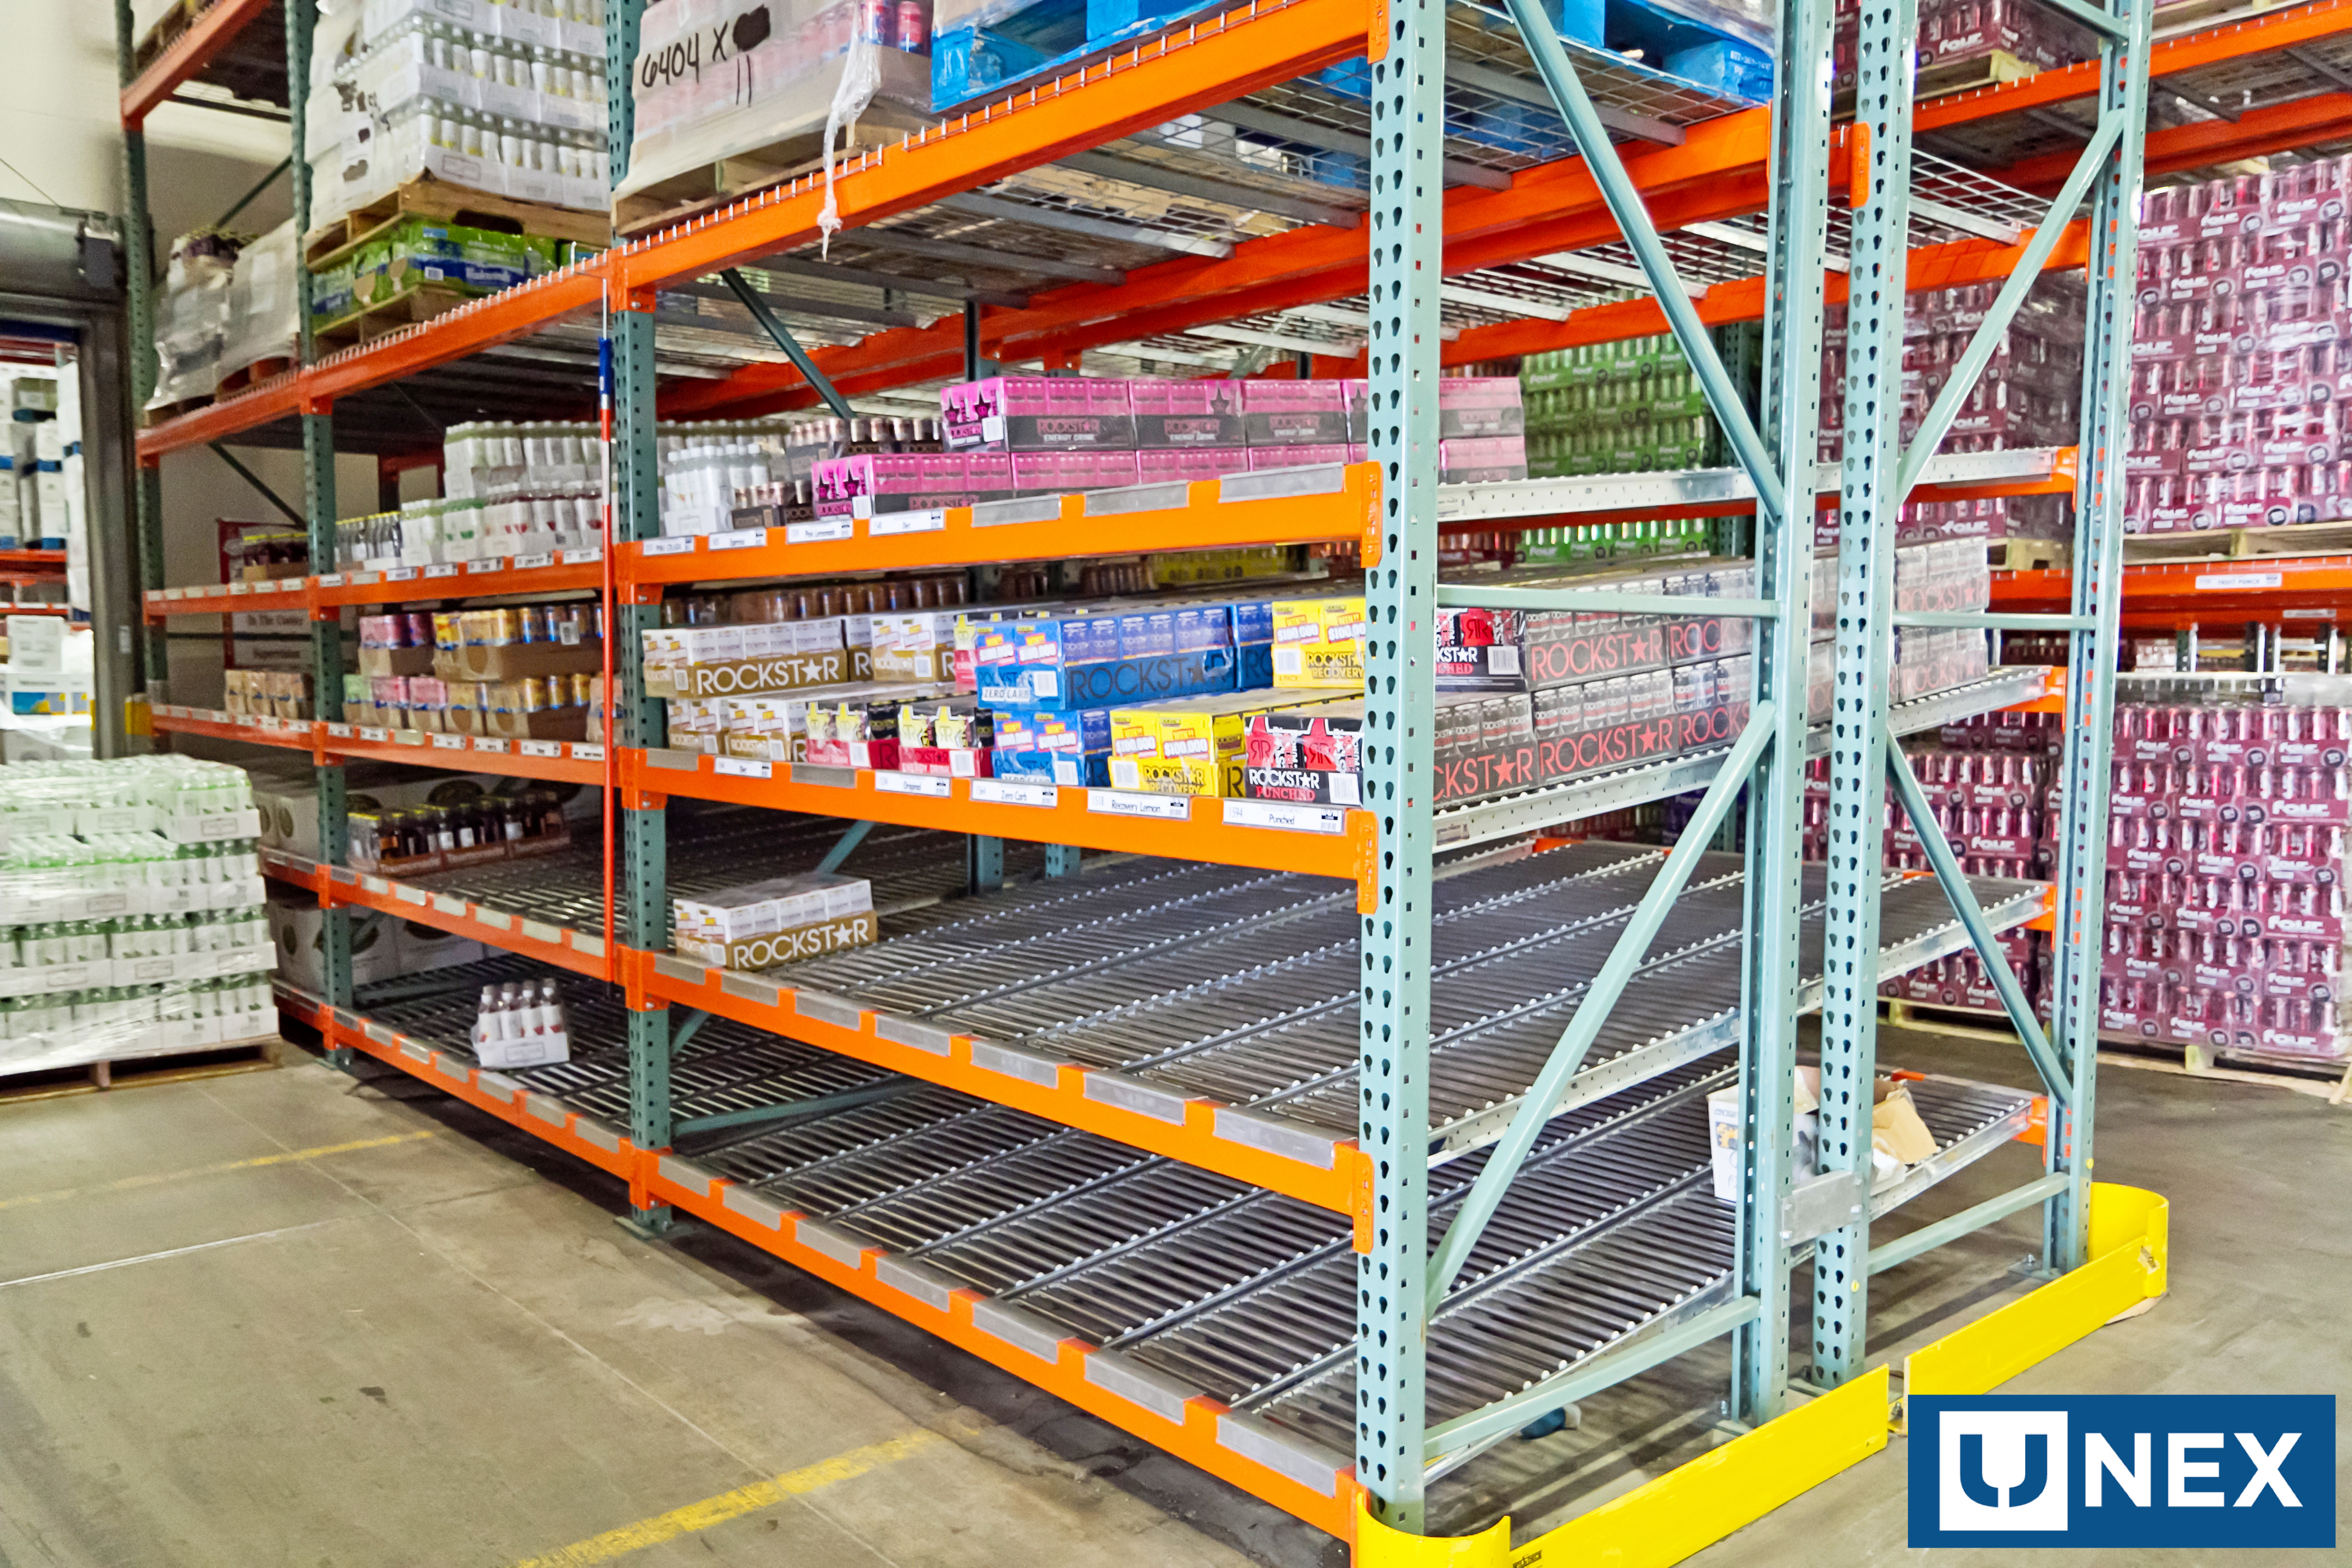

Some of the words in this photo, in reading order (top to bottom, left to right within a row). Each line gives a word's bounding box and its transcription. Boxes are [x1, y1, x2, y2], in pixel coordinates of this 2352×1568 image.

[642, 33, 700, 88] 6404
[712, 21, 728, 62] X
[696, 656, 840, 695] ROCKSTAR
[1531, 626, 1663, 681] ROCKSTAR
[1540, 718, 1673, 776] ROCKSTAR
[1249, 768, 1320, 789] ROCKSTAR
[1111, 799, 1137, 813] Recovery
[1140, 802, 1161, 812] Lemon
[1268, 813, 1295, 825] Punched
[733, 918, 869, 969] ROCKSTAR
